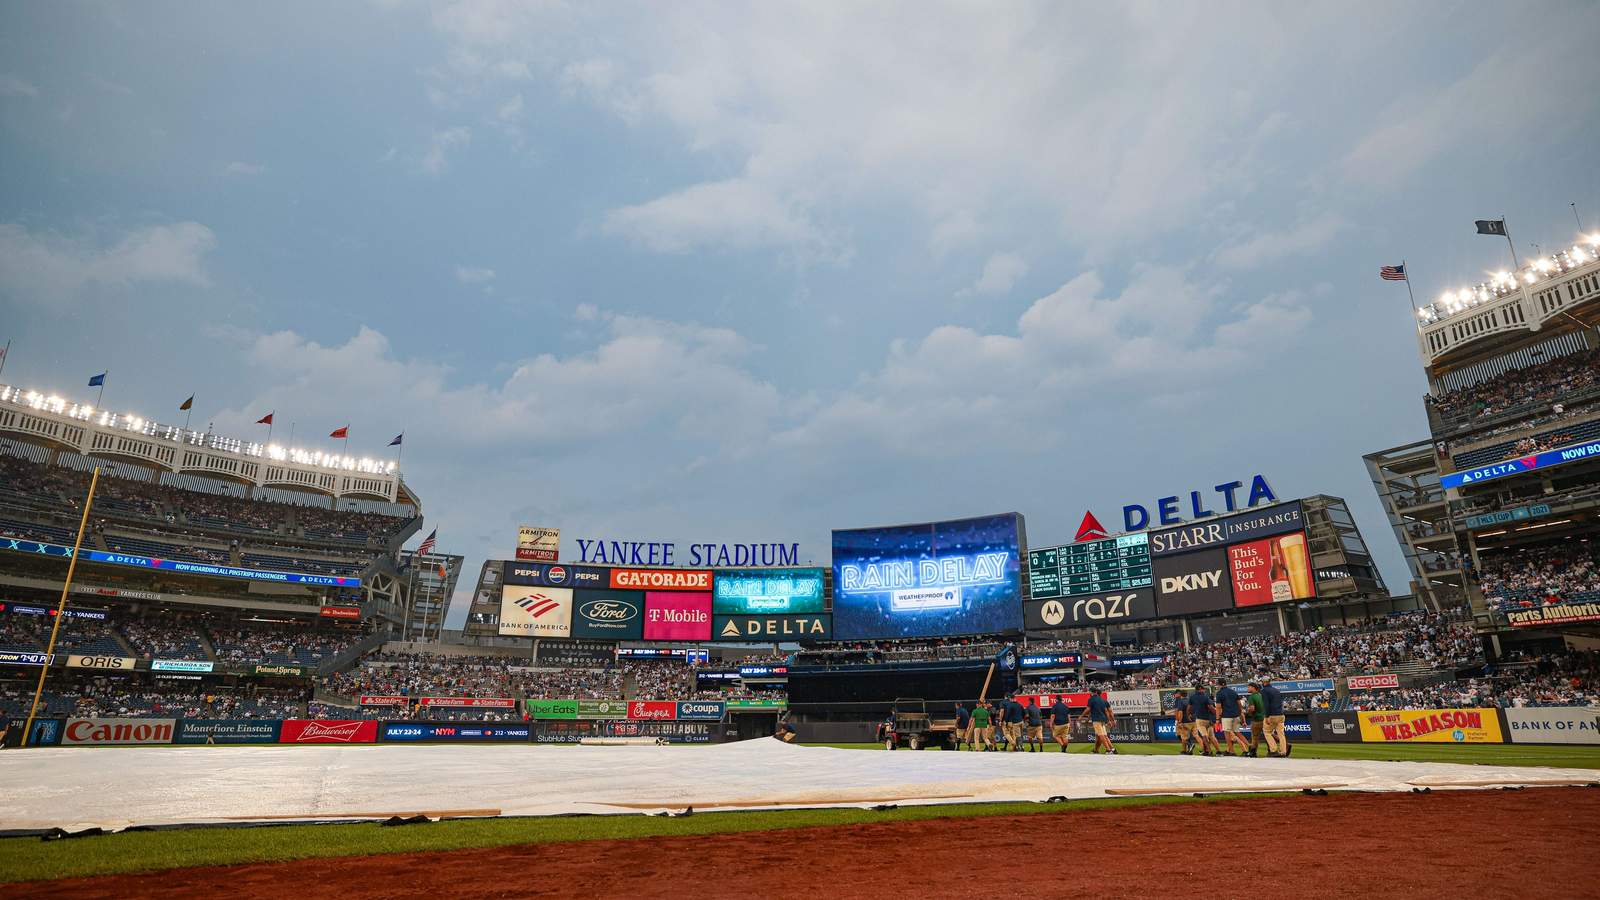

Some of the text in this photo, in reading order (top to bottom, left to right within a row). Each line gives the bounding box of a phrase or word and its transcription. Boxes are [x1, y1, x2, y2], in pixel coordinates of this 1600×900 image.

[1561, 446, 1586, 460] NOW
[1474, 463, 1517, 479] DELTA
[1122, 474, 1276, 532] DELTA
[1480, 505, 1548, 523] MLS CUP 2021
[1153, 510, 1300, 552] STARR INSURANCE
[576, 540, 800, 566] YANKEE STADIUM
[1231, 547, 1257, 559] This
[117, 556, 147, 565] DELTA
[1234, 556, 1264, 570] Bud's
[190, 565, 218, 573] BOARDING
[229, 569, 255, 578] PINSTRIPE
[514, 569, 540, 577] PEPSI
[575, 573, 600, 581] PEPSI
[842, 561, 915, 591] RAIN
[919, 552, 1009, 586] DELAY
[1236, 571, 1254, 580] For
[616, 572, 708, 587] GATORADE
[1161, 569, 1222, 594] DKNY
[96, 588, 118, 596] Audi
[120, 590, 146, 598] YANKEES
[719, 579, 818, 595] RAIN DELAY
[1237, 582, 1262, 592] You.
[589, 602, 627, 618] Ford
[1073, 594, 1137, 621] razr
[663, 608, 708, 623] Mobile
[1507, 609, 1542, 623] Parts
[747, 619, 825, 634] DELTA
[80, 656, 124, 668] ORIS
[255, 665, 301, 675] Poland Spring
[1349, 676, 1398, 688] Reebok
[529, 704, 551, 714] Uber
[553, 705, 576, 714] Eats
[694, 704, 719, 715] coupa
[1368, 714, 1401, 724] WHO BUT
[1511, 721, 1551, 729] BANK
[1556, 721, 1574, 729] OF
[66, 721, 172, 741] Canon
[183, 723, 273, 732] Montefiore Einstein
[304, 723, 356, 736] Budweiser
[1158, 725, 1172, 733] JULY
